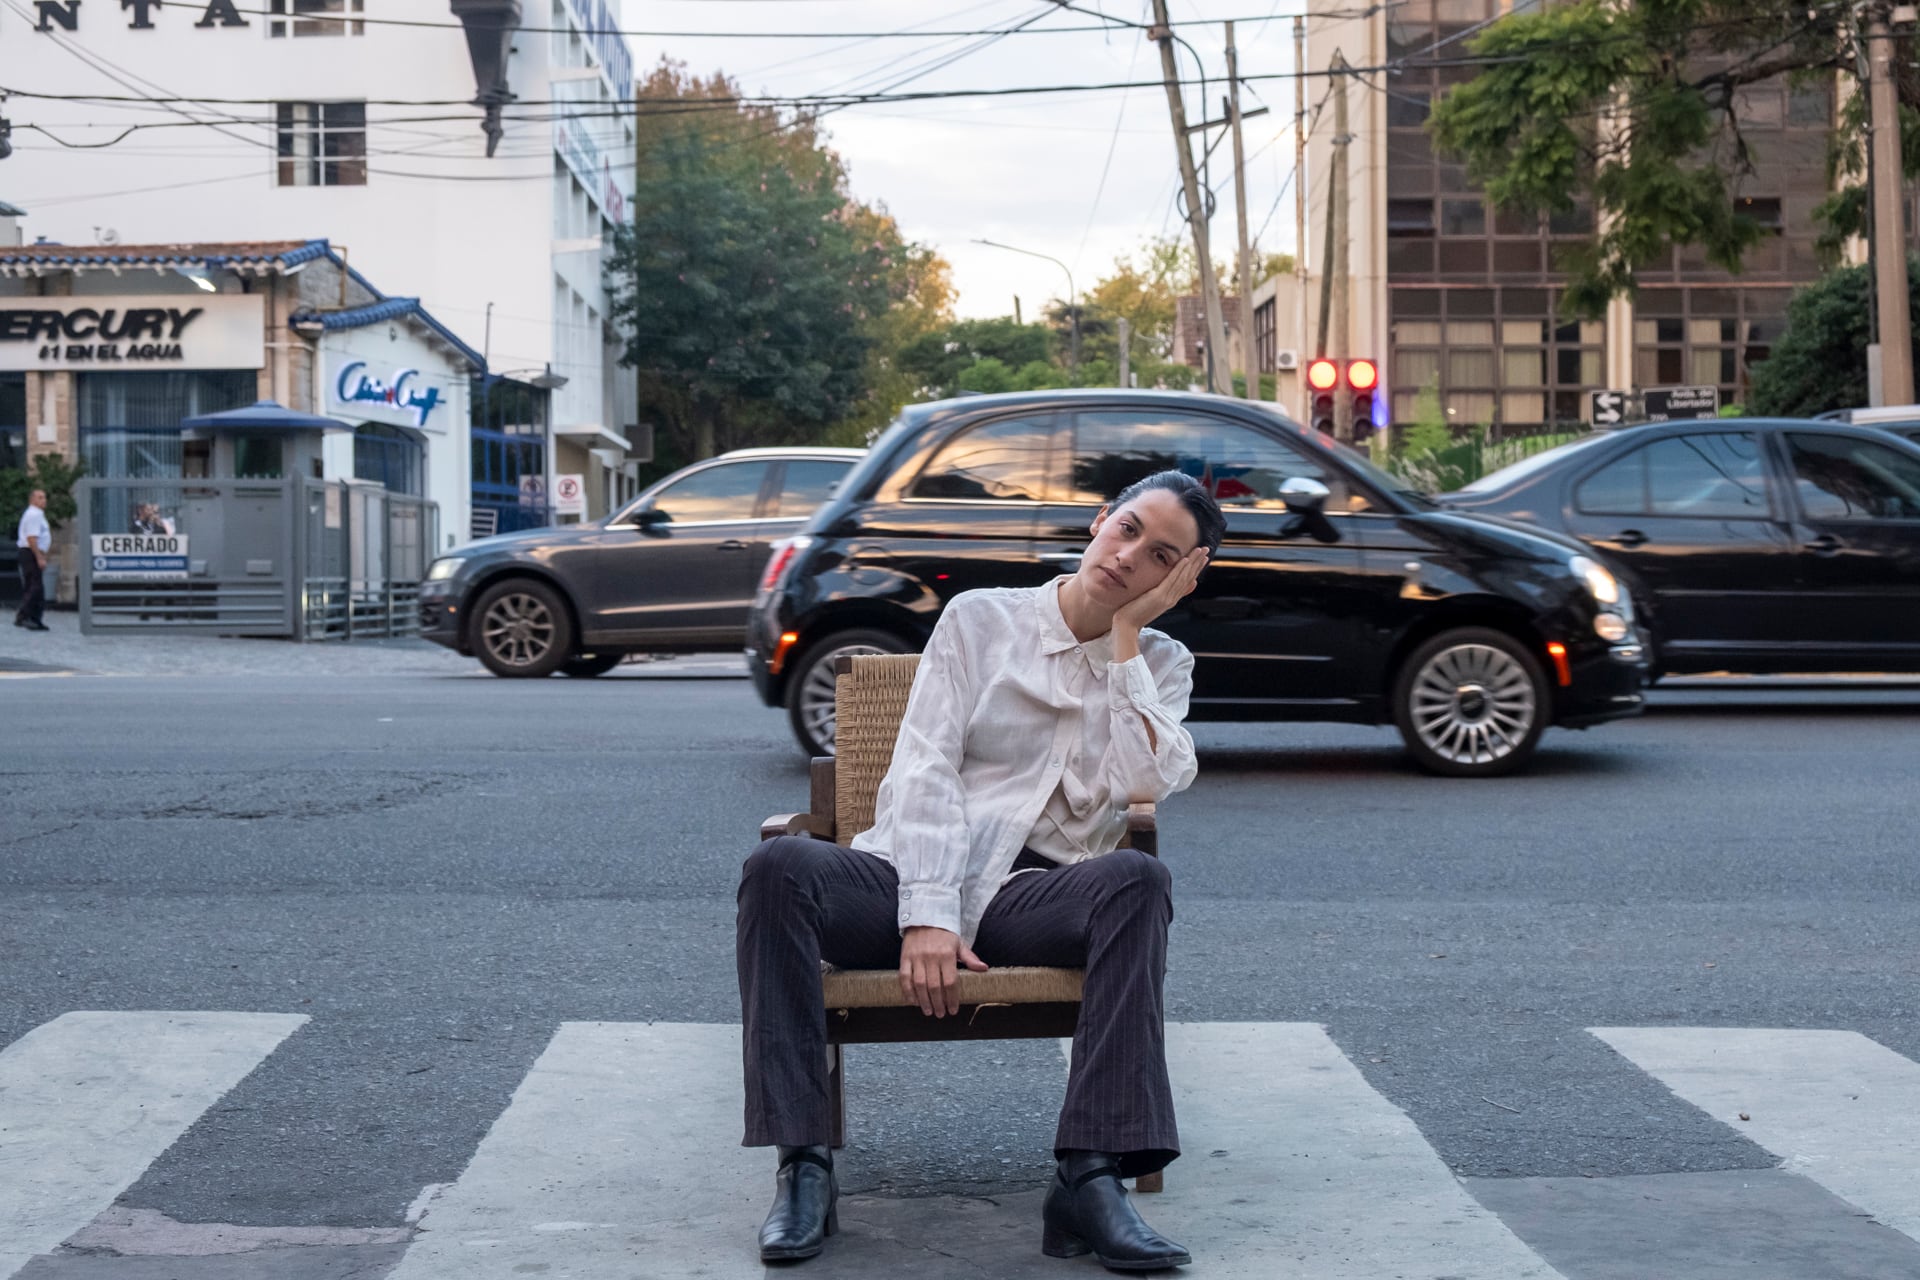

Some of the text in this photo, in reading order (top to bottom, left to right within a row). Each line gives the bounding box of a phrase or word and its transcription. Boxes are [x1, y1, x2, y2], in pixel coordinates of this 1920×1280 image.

[0, 308, 203, 341] ERCURY
[65, 345, 94, 360] EN
[96, 345, 122, 360] EL
[126, 345, 183, 360] AGUA
[1666, 399, 1713, 409] Libertador
[101, 537, 178, 553] CERRADO
